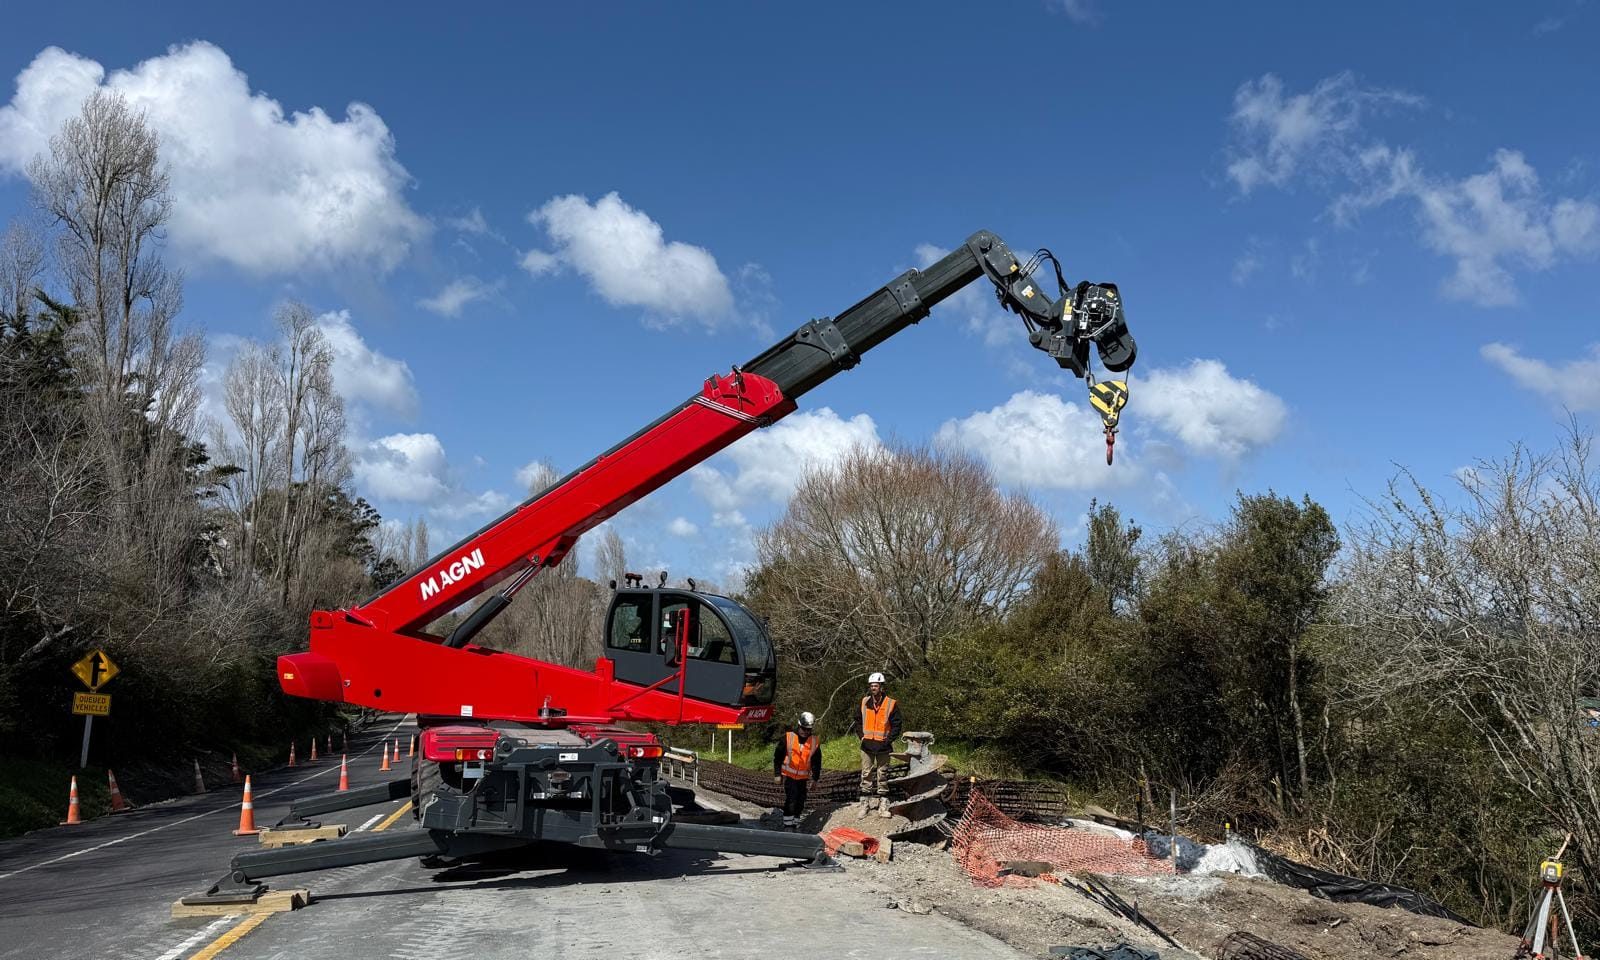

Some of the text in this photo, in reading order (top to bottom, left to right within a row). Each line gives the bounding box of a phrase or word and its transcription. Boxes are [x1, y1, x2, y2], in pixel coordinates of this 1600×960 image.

[420, 547, 485, 601] MAGNI
[79, 695, 107, 704] QUEUED
[75, 703, 108, 712] VEHICLES
